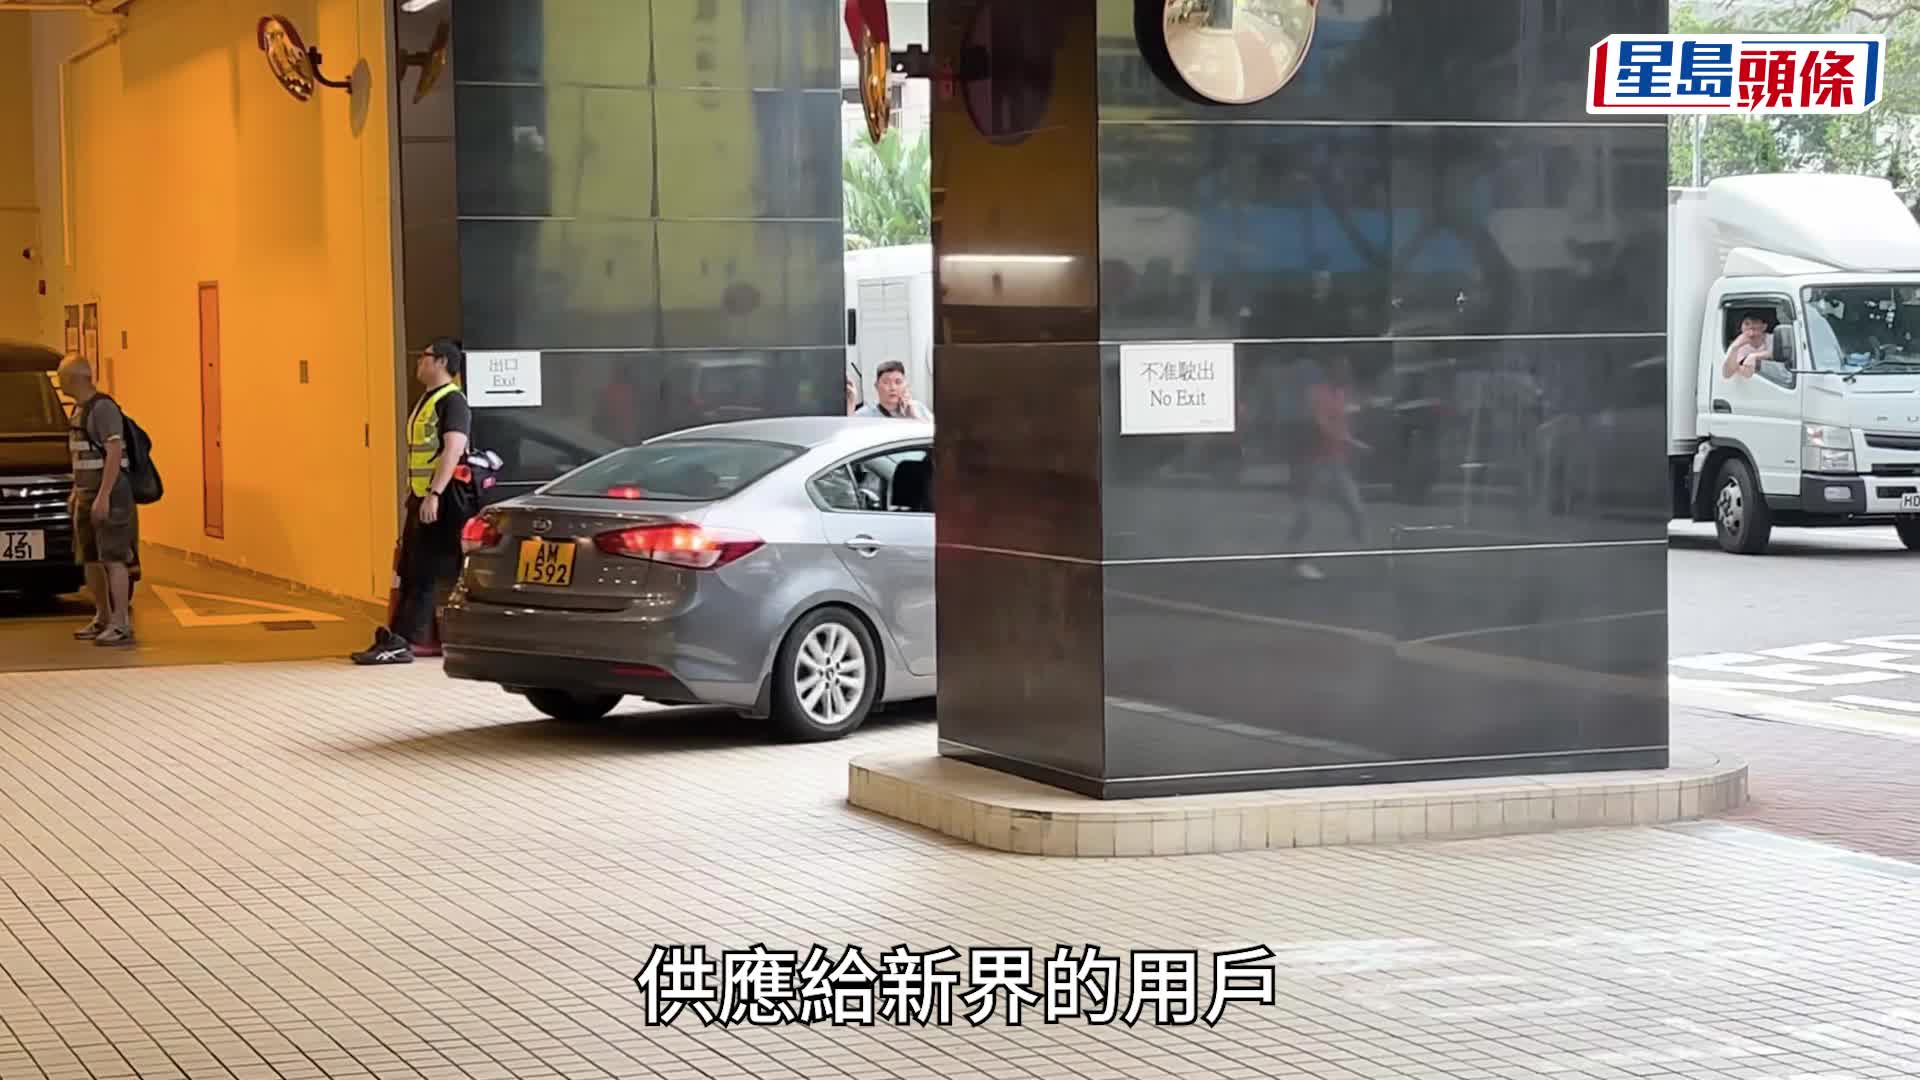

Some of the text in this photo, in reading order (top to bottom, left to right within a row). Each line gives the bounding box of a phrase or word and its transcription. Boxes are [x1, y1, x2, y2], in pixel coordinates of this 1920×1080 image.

[489, 358, 518, 373] 出口
[1140, 360, 1214, 381] 不准駛出
[493, 375, 515, 387] Exit
[1150, 389, 1206, 407] No Exit
[5, 532, 28, 546] TZ
[3, 545, 32, 559] 451
[536, 544, 559, 563] AM
[523, 563, 567, 583] 1592
